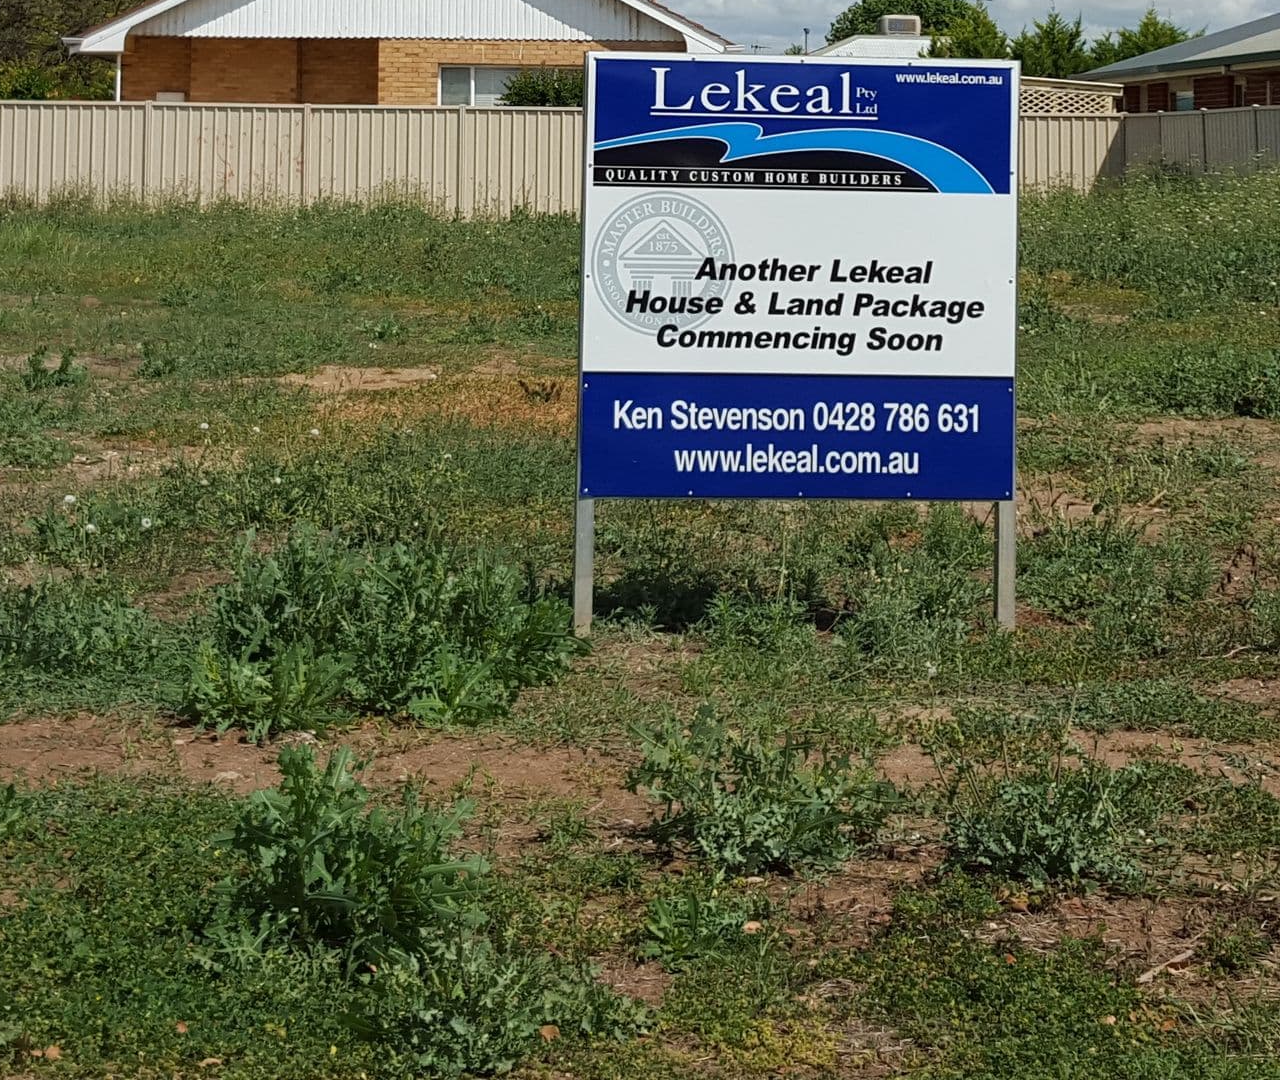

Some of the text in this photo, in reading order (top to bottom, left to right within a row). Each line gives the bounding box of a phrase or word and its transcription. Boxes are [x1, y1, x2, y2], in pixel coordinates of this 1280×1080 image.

[650, 67, 853, 114] Lekeal
[895, 72, 1003, 86] www.lekeal.com.au
[856, 87, 878, 101] Pty
[856, 103, 878, 114] Ltd
[605, 169, 903, 186] QUALITY CUSTOM HOME BUILDERS
[601, 200, 725, 257] MASTER BUILDERS
[656, 232, 671, 240] est
[649, 241, 679, 252] 1875
[694, 257, 933, 284] Another Lekeal
[625, 290, 723, 314] House
[734, 291, 756, 315] &
[767, 292, 845, 316] Land
[852, 293, 985, 325] Package
[656, 324, 943, 357] Commencing Soon
[613, 399, 980, 433] Ken Stevenson 0428 786 631
[674, 443, 920, 475] www.lekeal.com.au
